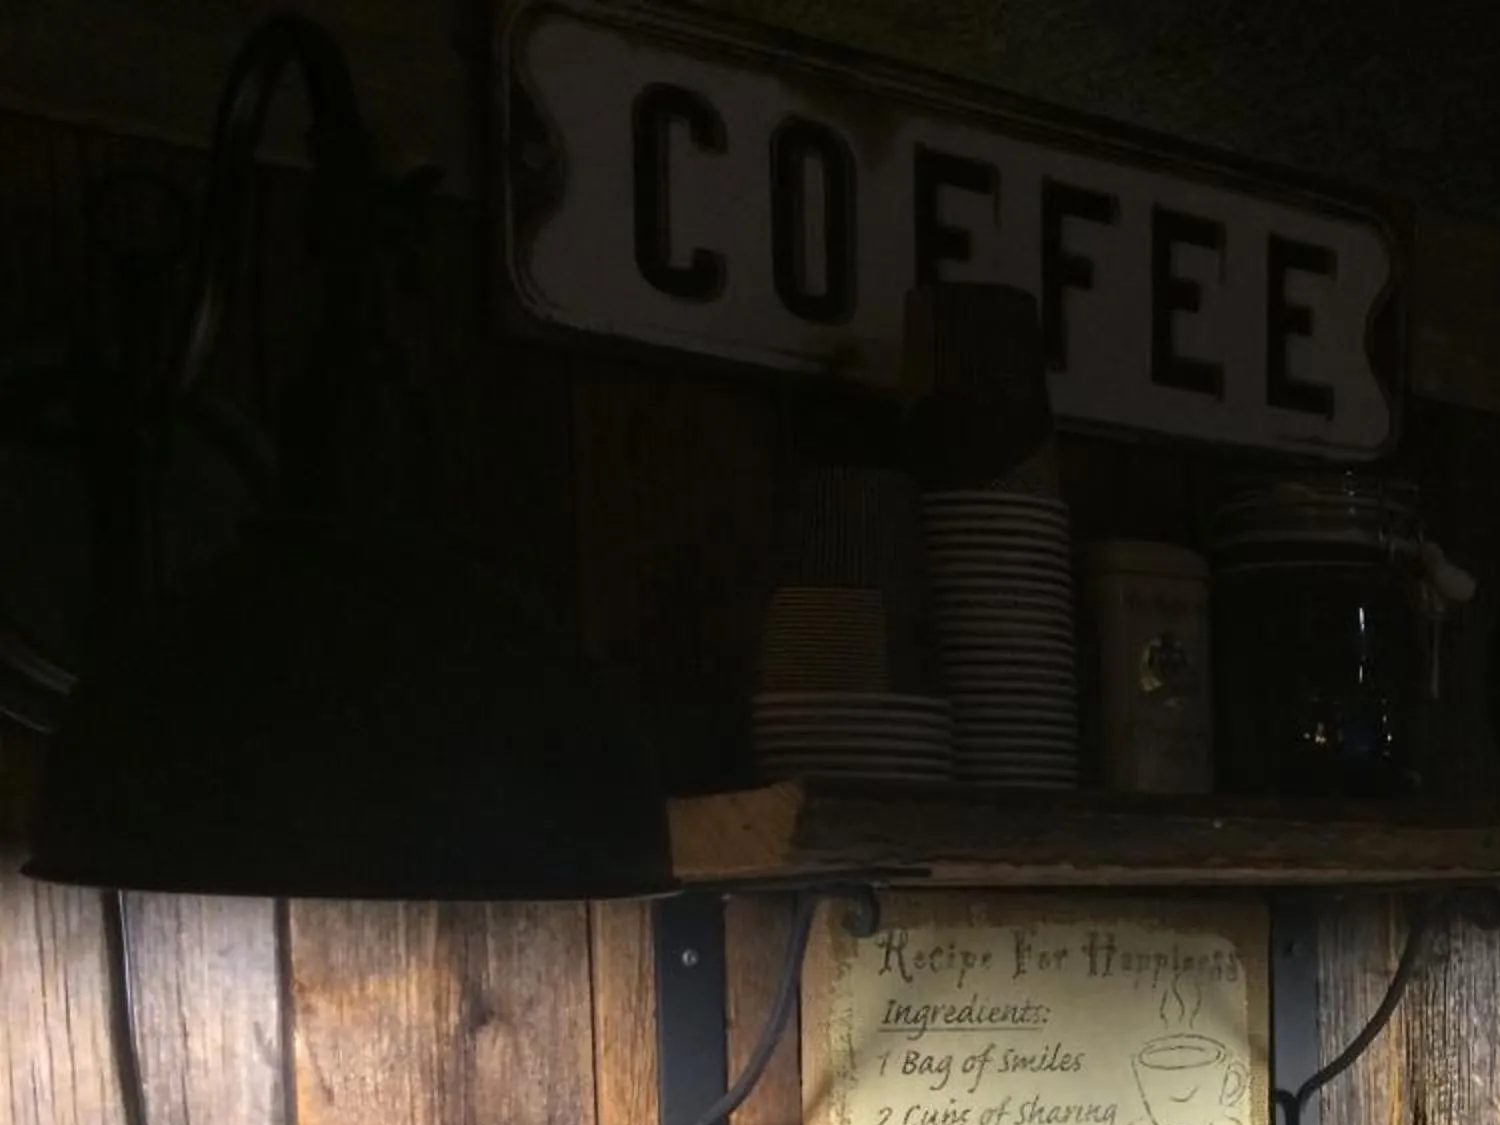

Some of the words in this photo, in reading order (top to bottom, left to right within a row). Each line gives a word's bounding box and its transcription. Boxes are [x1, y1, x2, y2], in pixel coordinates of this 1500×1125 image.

[632, 82, 1339, 422] COFFEE
[1011, 928, 1068, 980] For
[882, 994, 1051, 1040] Ingredients:
[902, 1051, 951, 1091] Bag
[962, 1043, 995, 1093] of
